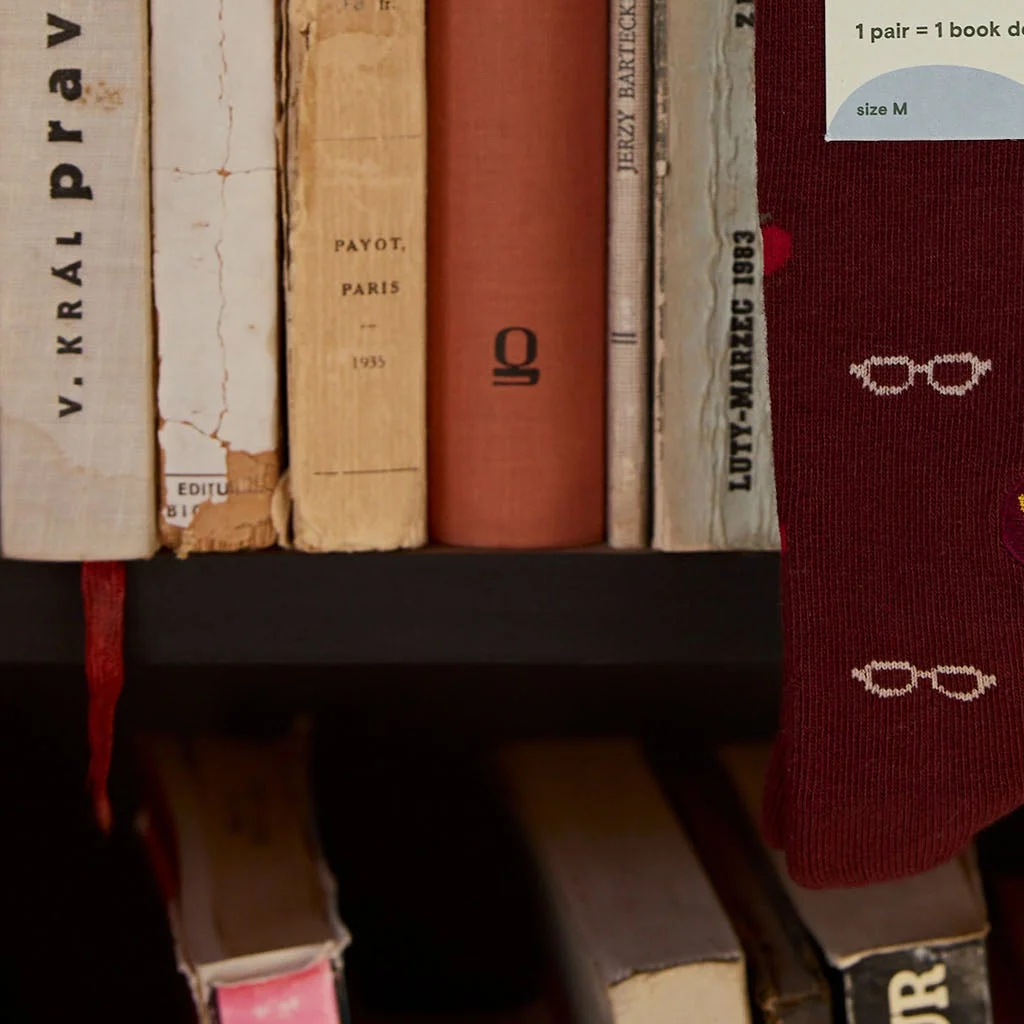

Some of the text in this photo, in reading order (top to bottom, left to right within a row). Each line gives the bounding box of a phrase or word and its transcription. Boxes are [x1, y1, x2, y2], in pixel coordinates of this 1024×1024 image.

[854, 23, 865, 39] 1
[870, 22, 910, 43] pair
[934, 22, 944, 38] 1
[949, 21, 1001, 39] book
[856, 102, 908, 116] size M
[616, 109, 639, 174] JERZY
[333, 236, 406, 253] PAYOT,
[51, 231, 84, 356] KRÁL
[341, 280, 400, 296] PARIS
[352, 354, 387, 370] 1935
[727, 229, 756, 493] LUTY-MARZEC 1983
